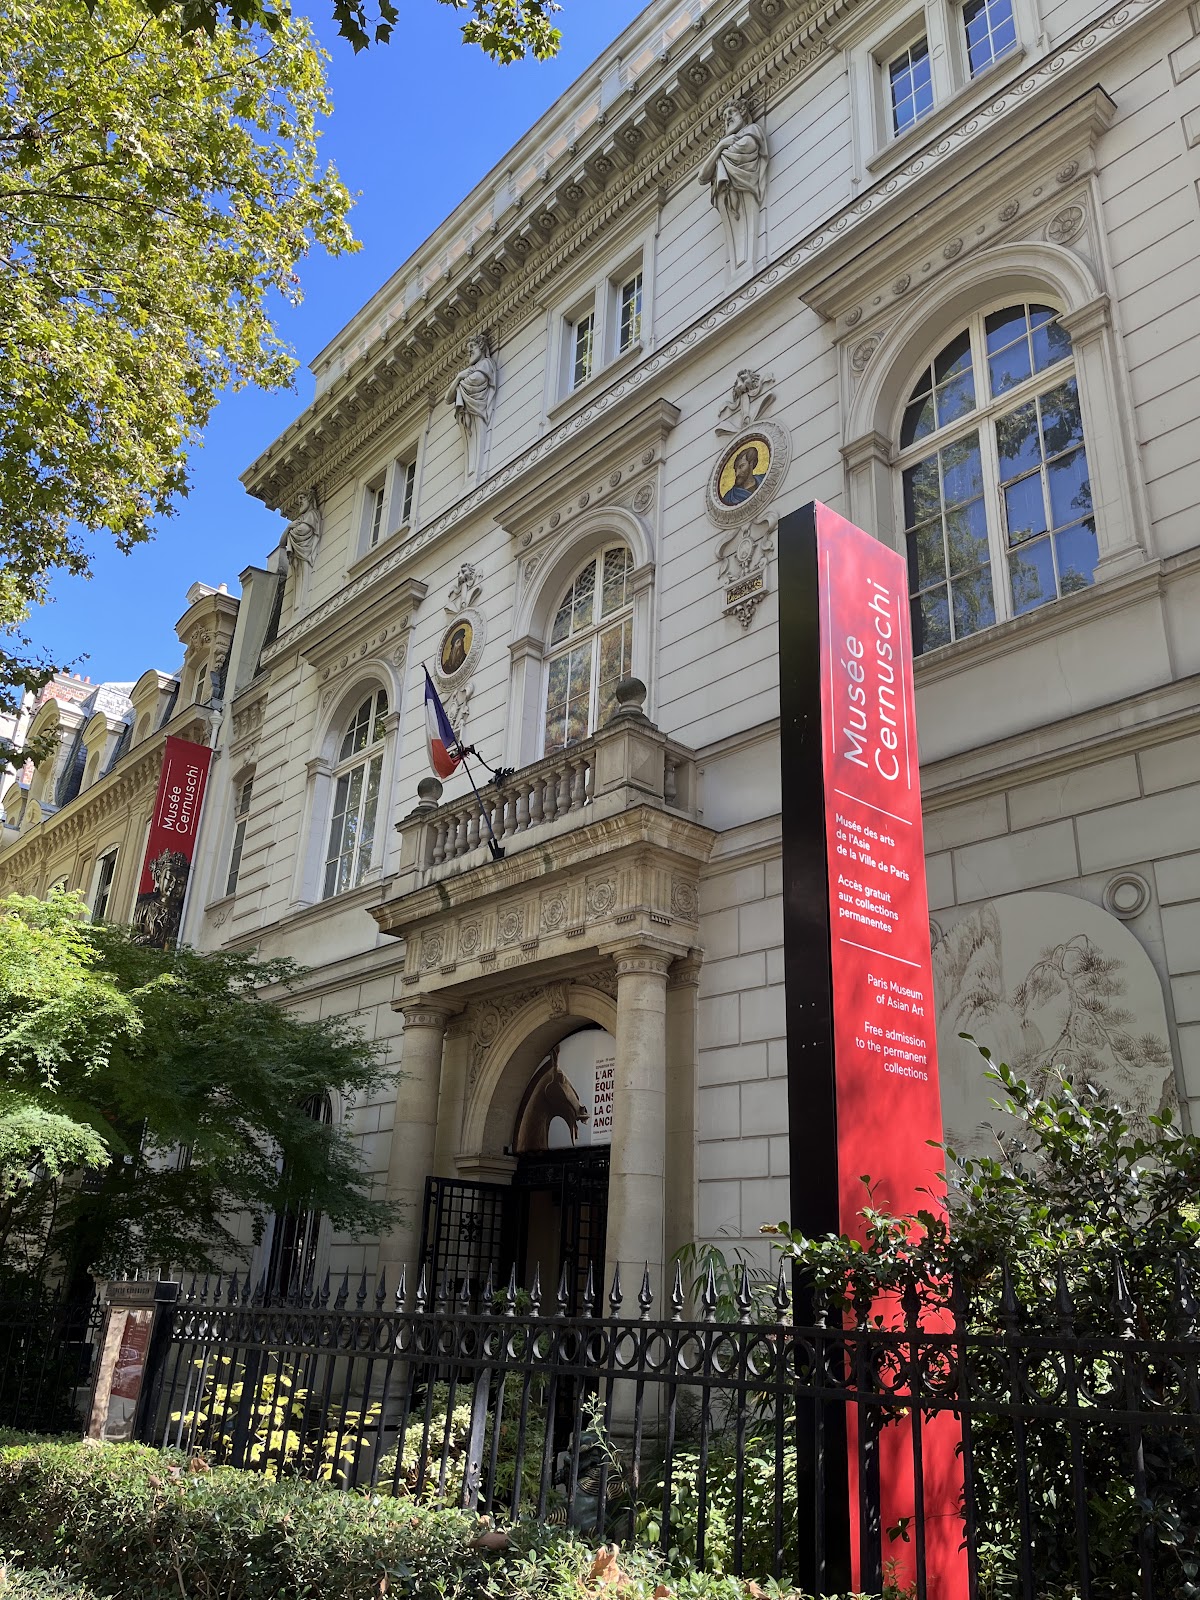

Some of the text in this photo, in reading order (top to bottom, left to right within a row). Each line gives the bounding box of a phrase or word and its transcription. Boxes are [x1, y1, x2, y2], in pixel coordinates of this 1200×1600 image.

[867, 578, 899, 781] Cernuschi
[841, 635, 869, 768] Musée
[162, 786, 181, 831] Musée
[176, 764, 199, 834] Cernuschi
[835, 813, 895, 847] Musée des arts
[836, 829, 871, 851] de l'Asie
[836, 844, 910, 881] de la Ville de Paris
[838, 874, 892, 903] Accès gratuit
[838, 891, 899, 921] aux collections
[839, 907, 893, 933] permanentes
[867, 973, 924, 1000] Paris Museum
[876, 994, 925, 1017] of Asian Art
[864, 1021, 926, 1049] Free admission
[855, 1037, 927, 1065] to the permanent
[595, 1068, 615, 1080] L'AR
[884, 1062, 928, 1081] collections
[594, 1105, 604, 1116] LA
